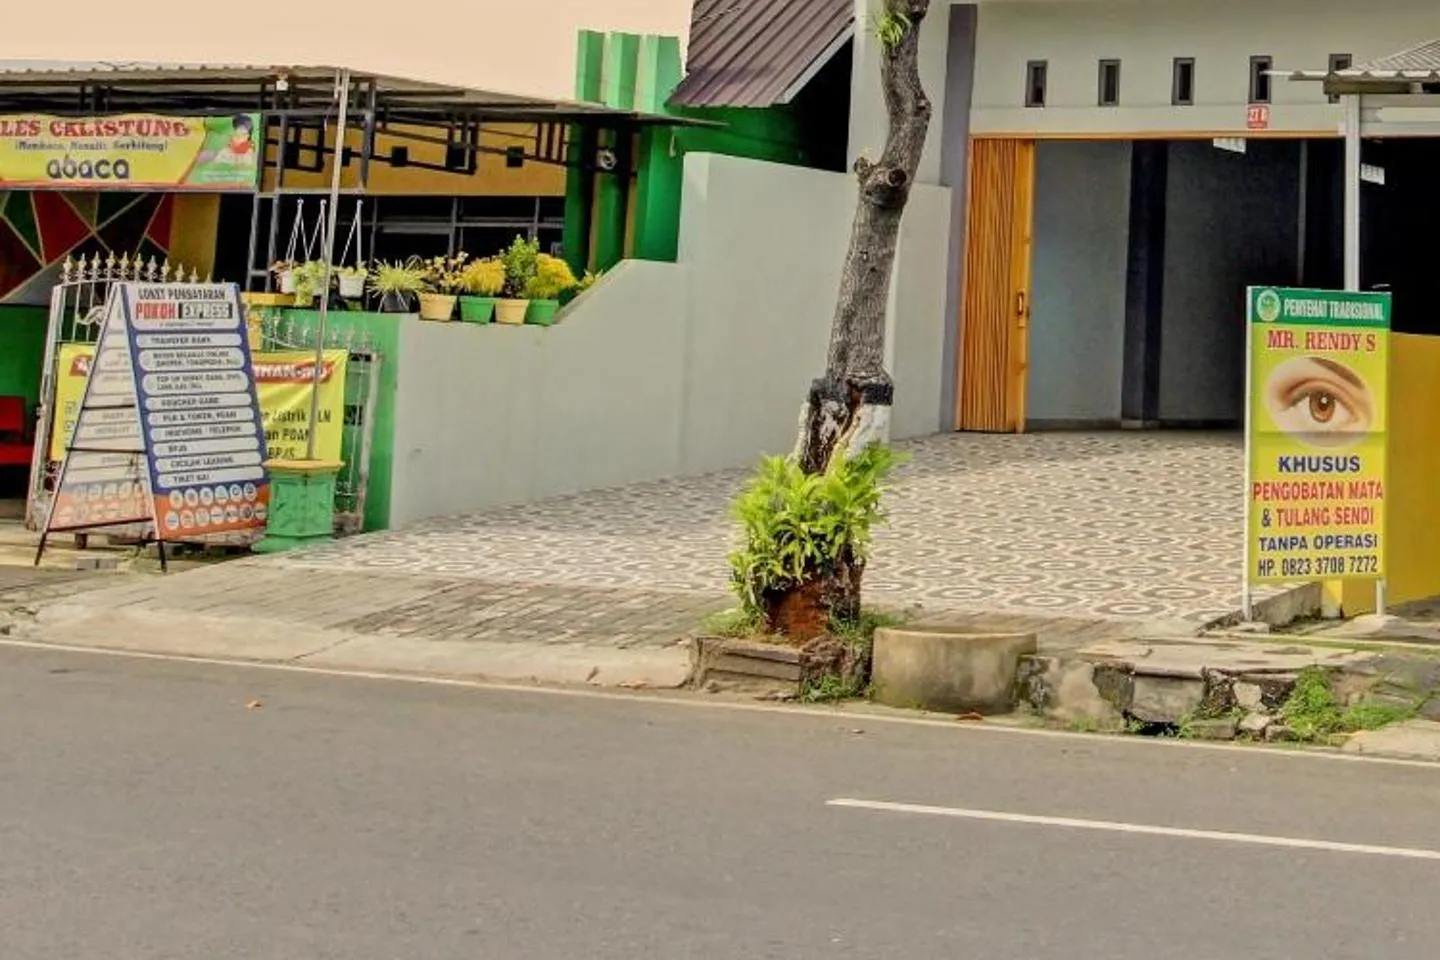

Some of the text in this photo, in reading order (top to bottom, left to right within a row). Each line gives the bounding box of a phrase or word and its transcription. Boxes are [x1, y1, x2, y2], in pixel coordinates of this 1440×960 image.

[1, 120, 40, 137] LES
[1268, 330, 1376, 352] MR. RENDY S
[1278, 456, 1361, 473] KHUSUS
[1253, 480, 1383, 501] PENGOBATAN MATA
[1262, 506, 1374, 527] & TULANG SENDI
[1259, 534, 1378, 551] TANPA OPERASI
[1258, 555, 1378, 577] HP. 0823 3708 7272
